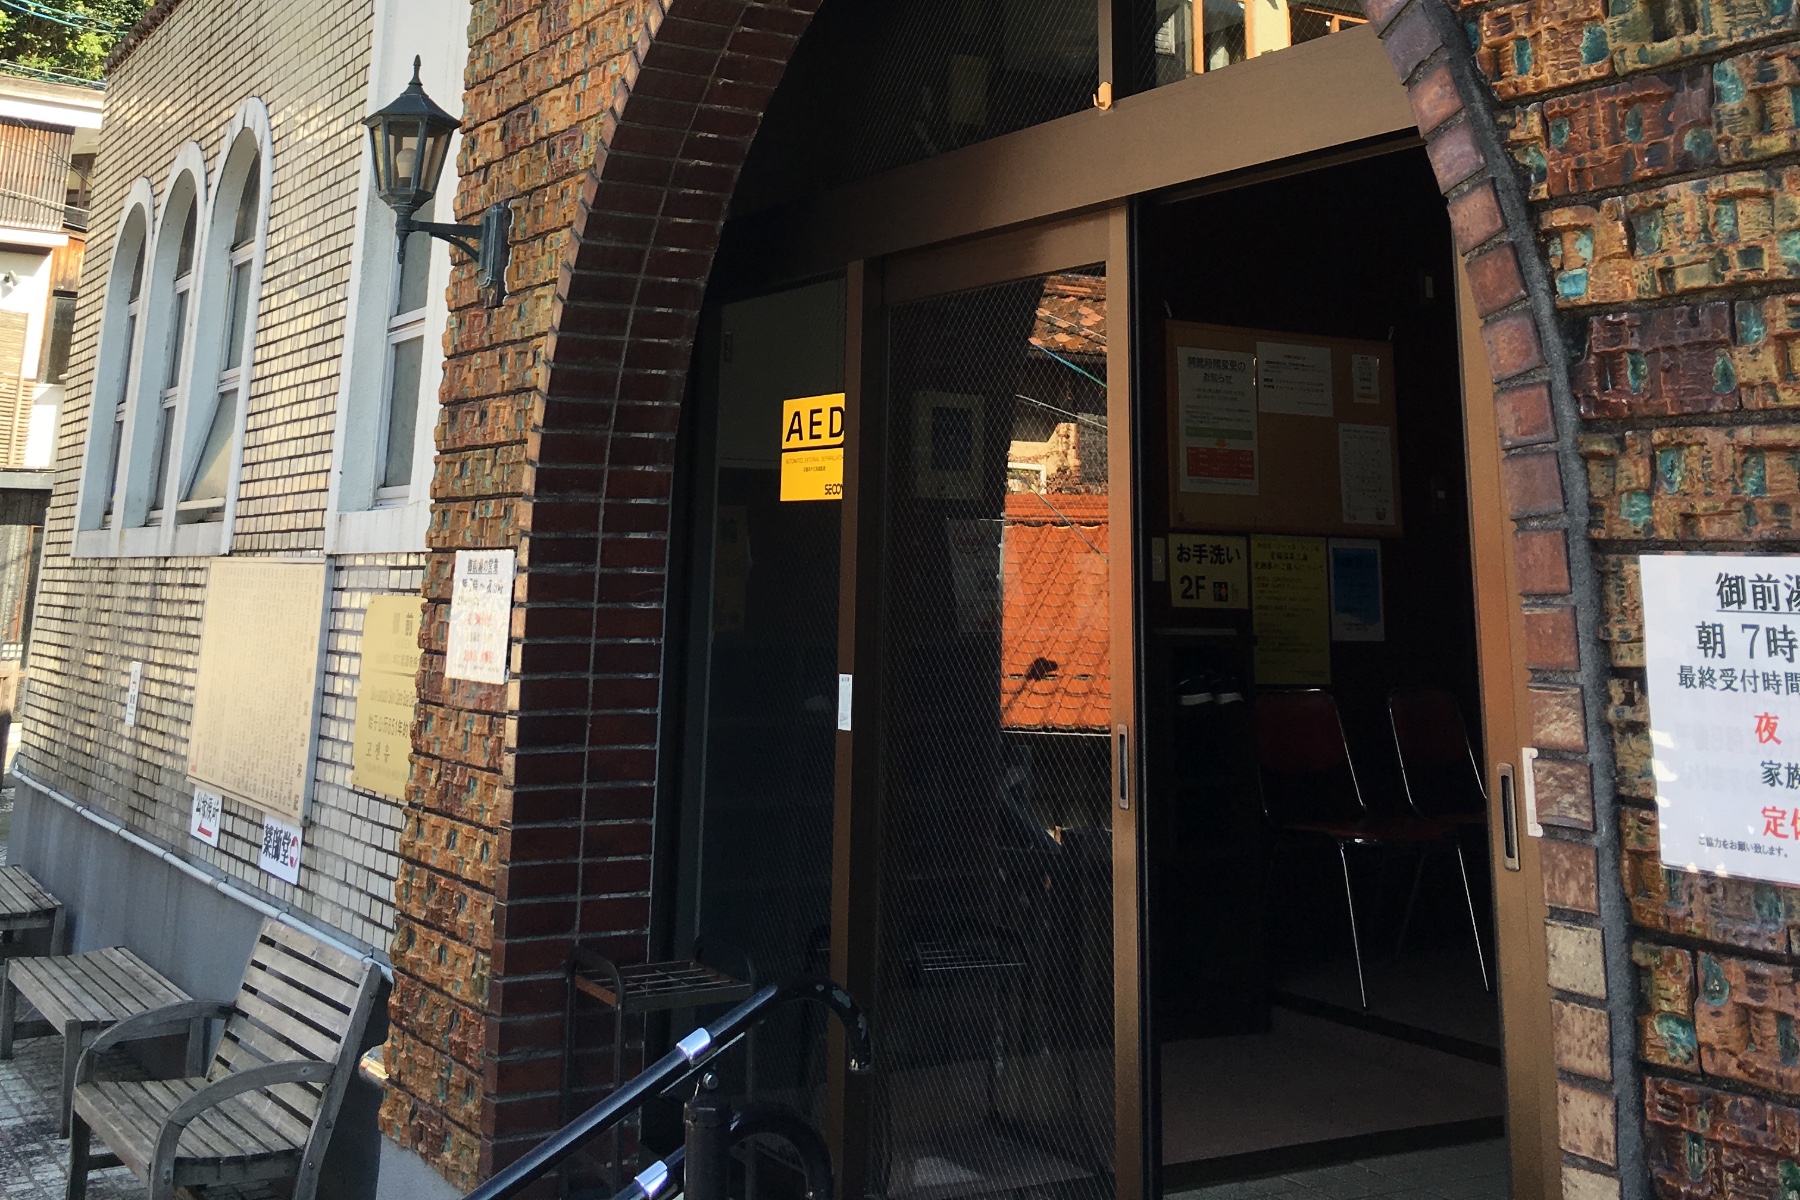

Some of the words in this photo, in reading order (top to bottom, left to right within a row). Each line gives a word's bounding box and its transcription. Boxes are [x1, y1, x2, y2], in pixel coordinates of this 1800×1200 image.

[785, 406, 845, 442] AED
[824, 483, 843, 495] SECO
[1177, 543, 1241, 565] お手洗い
[1180, 575, 1206, 600] 2F
[1677, 665, 1800, 696] 最終受付時間
[1753, 711, 1783, 745] 夜
[262, 823, 291, 867] 薬師堂
